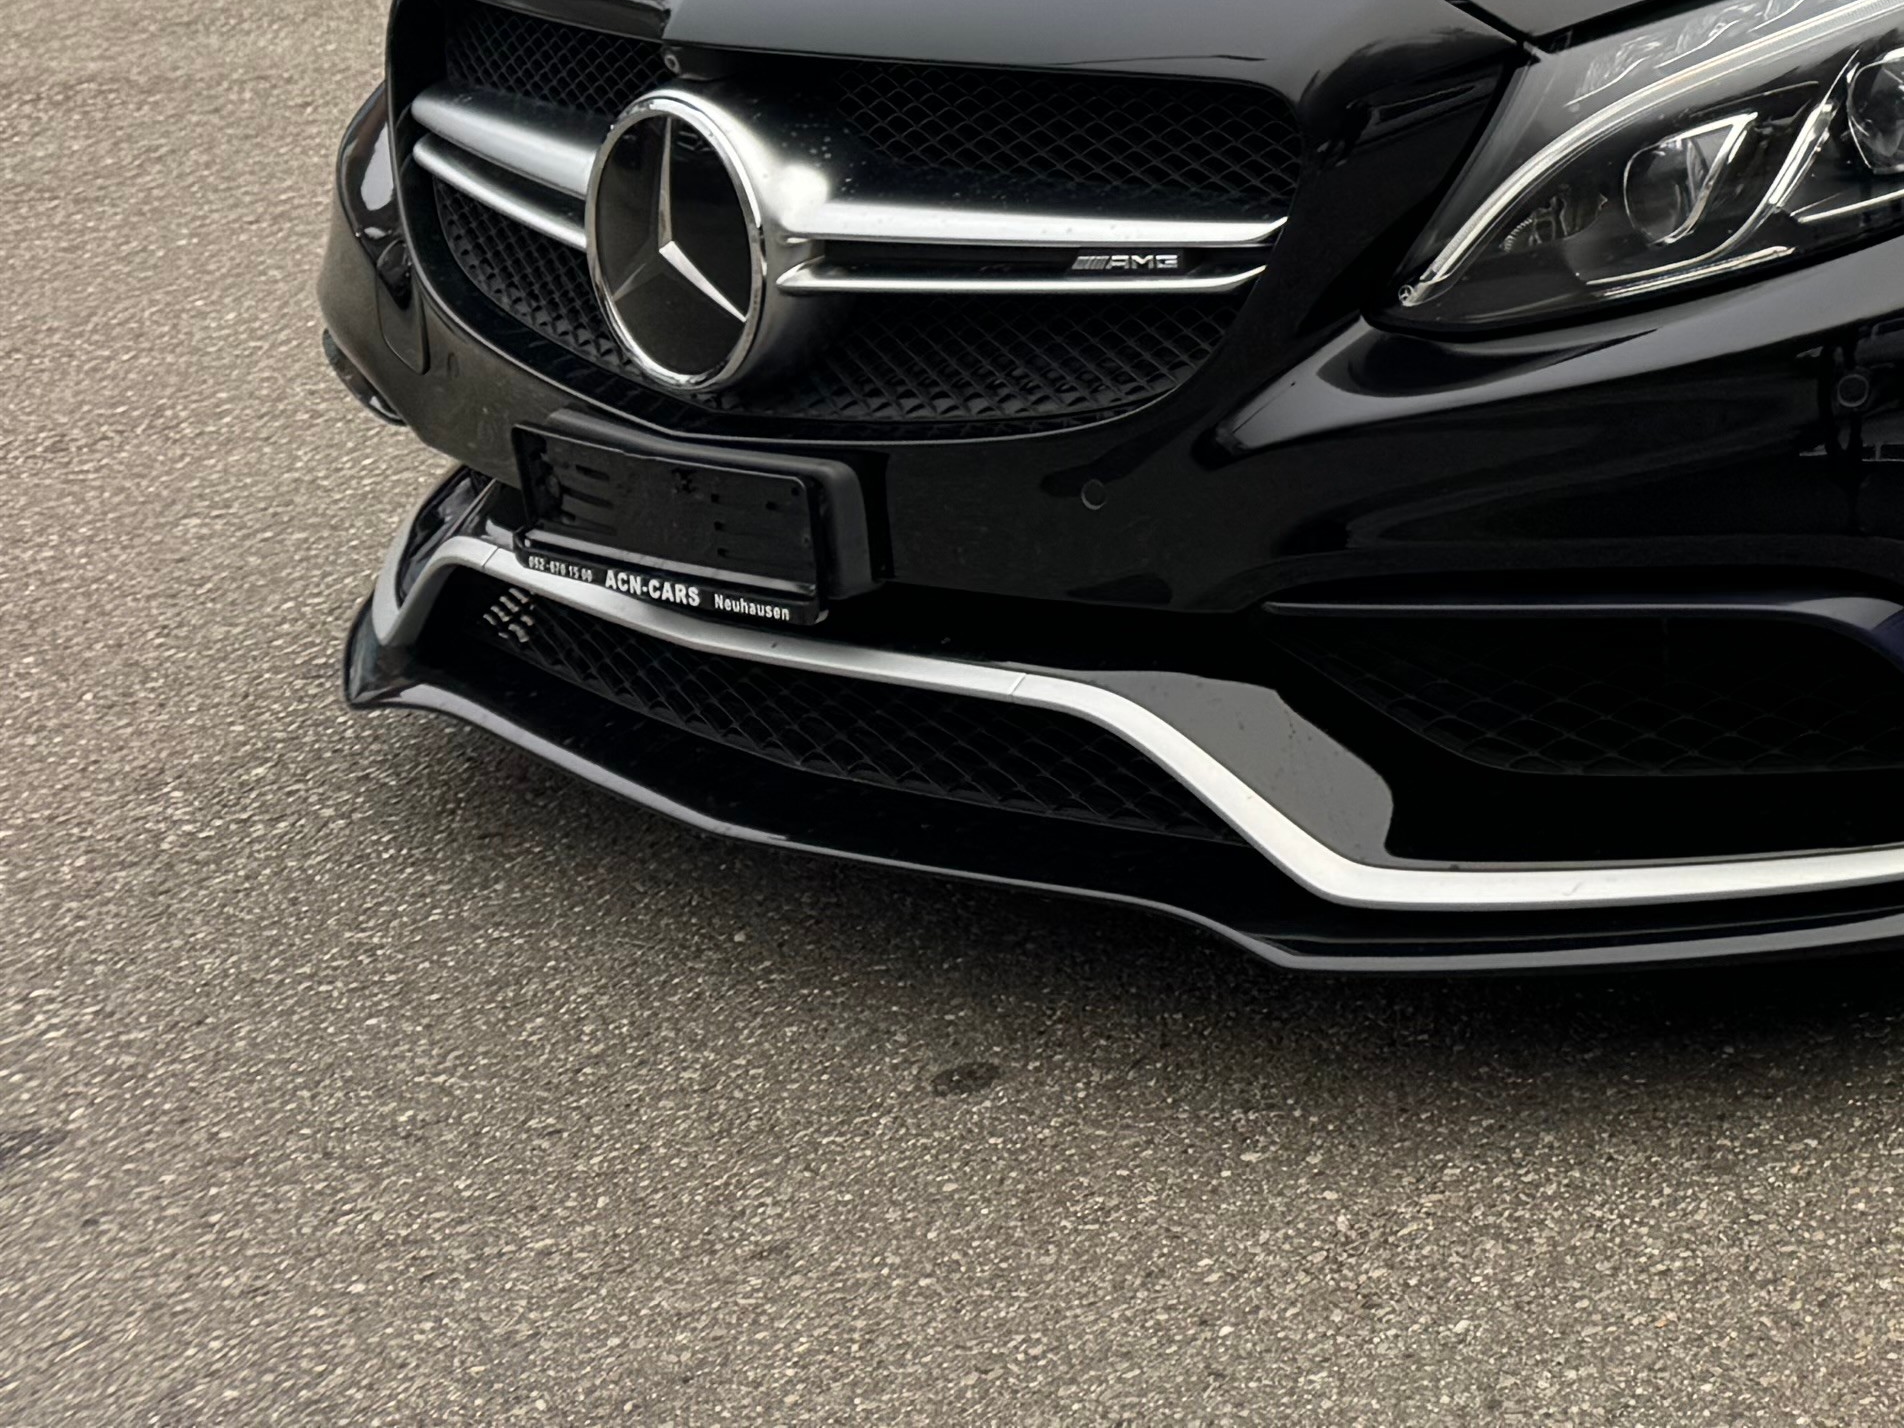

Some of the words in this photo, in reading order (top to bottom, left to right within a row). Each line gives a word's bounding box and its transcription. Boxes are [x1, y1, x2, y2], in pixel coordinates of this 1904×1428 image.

[1105, 254, 1179, 270] AMG
[604, 569, 701, 607] ACN-CARS
[714, 593, 791, 621] Neuhausen
